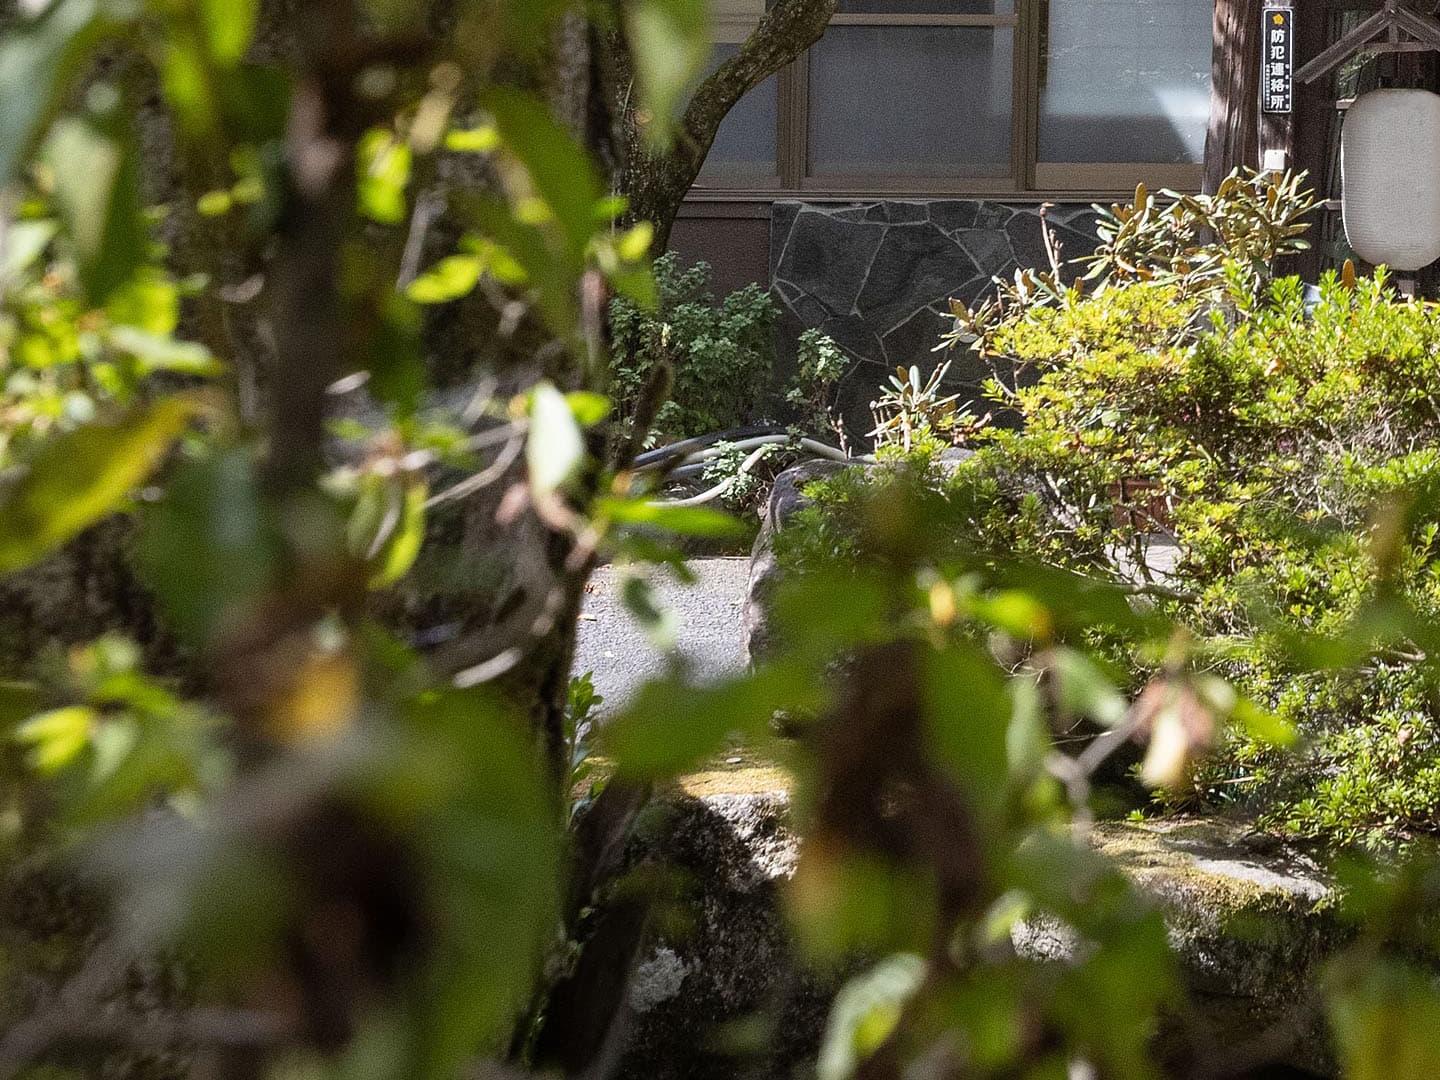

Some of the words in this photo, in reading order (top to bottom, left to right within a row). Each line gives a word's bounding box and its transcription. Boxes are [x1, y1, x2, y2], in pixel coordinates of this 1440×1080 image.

[1270, 28, 1286, 109] 防犯連絡所
